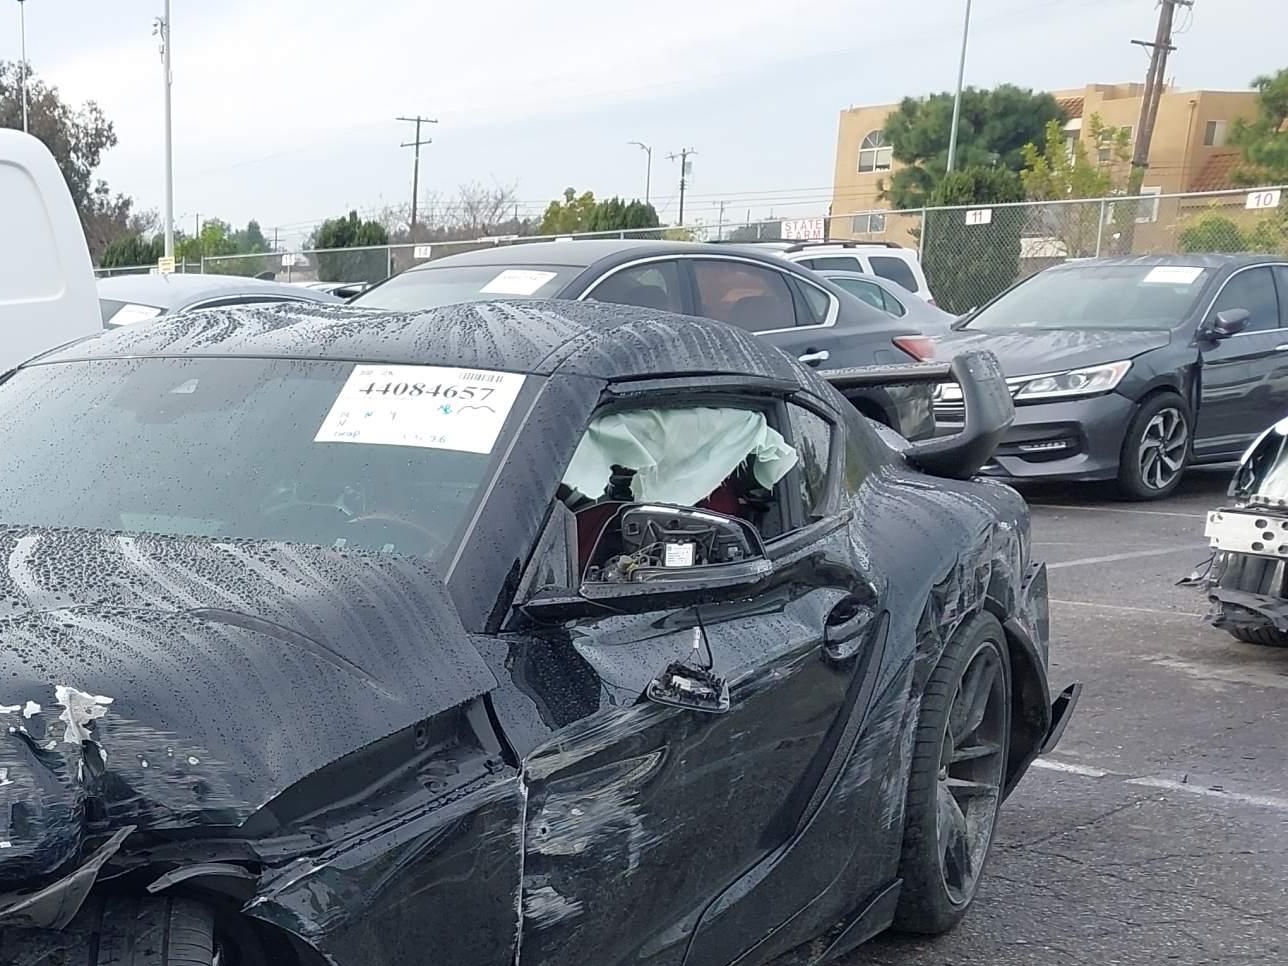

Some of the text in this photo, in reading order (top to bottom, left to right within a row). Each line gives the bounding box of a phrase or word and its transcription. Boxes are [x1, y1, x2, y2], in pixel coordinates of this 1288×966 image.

[1254, 193, 1273, 206] 10
[972, 211, 982, 223] 11
[785, 220, 823, 231] STATE
[786, 230, 821, 240] FARM
[359, 382, 495, 401] 44084657
